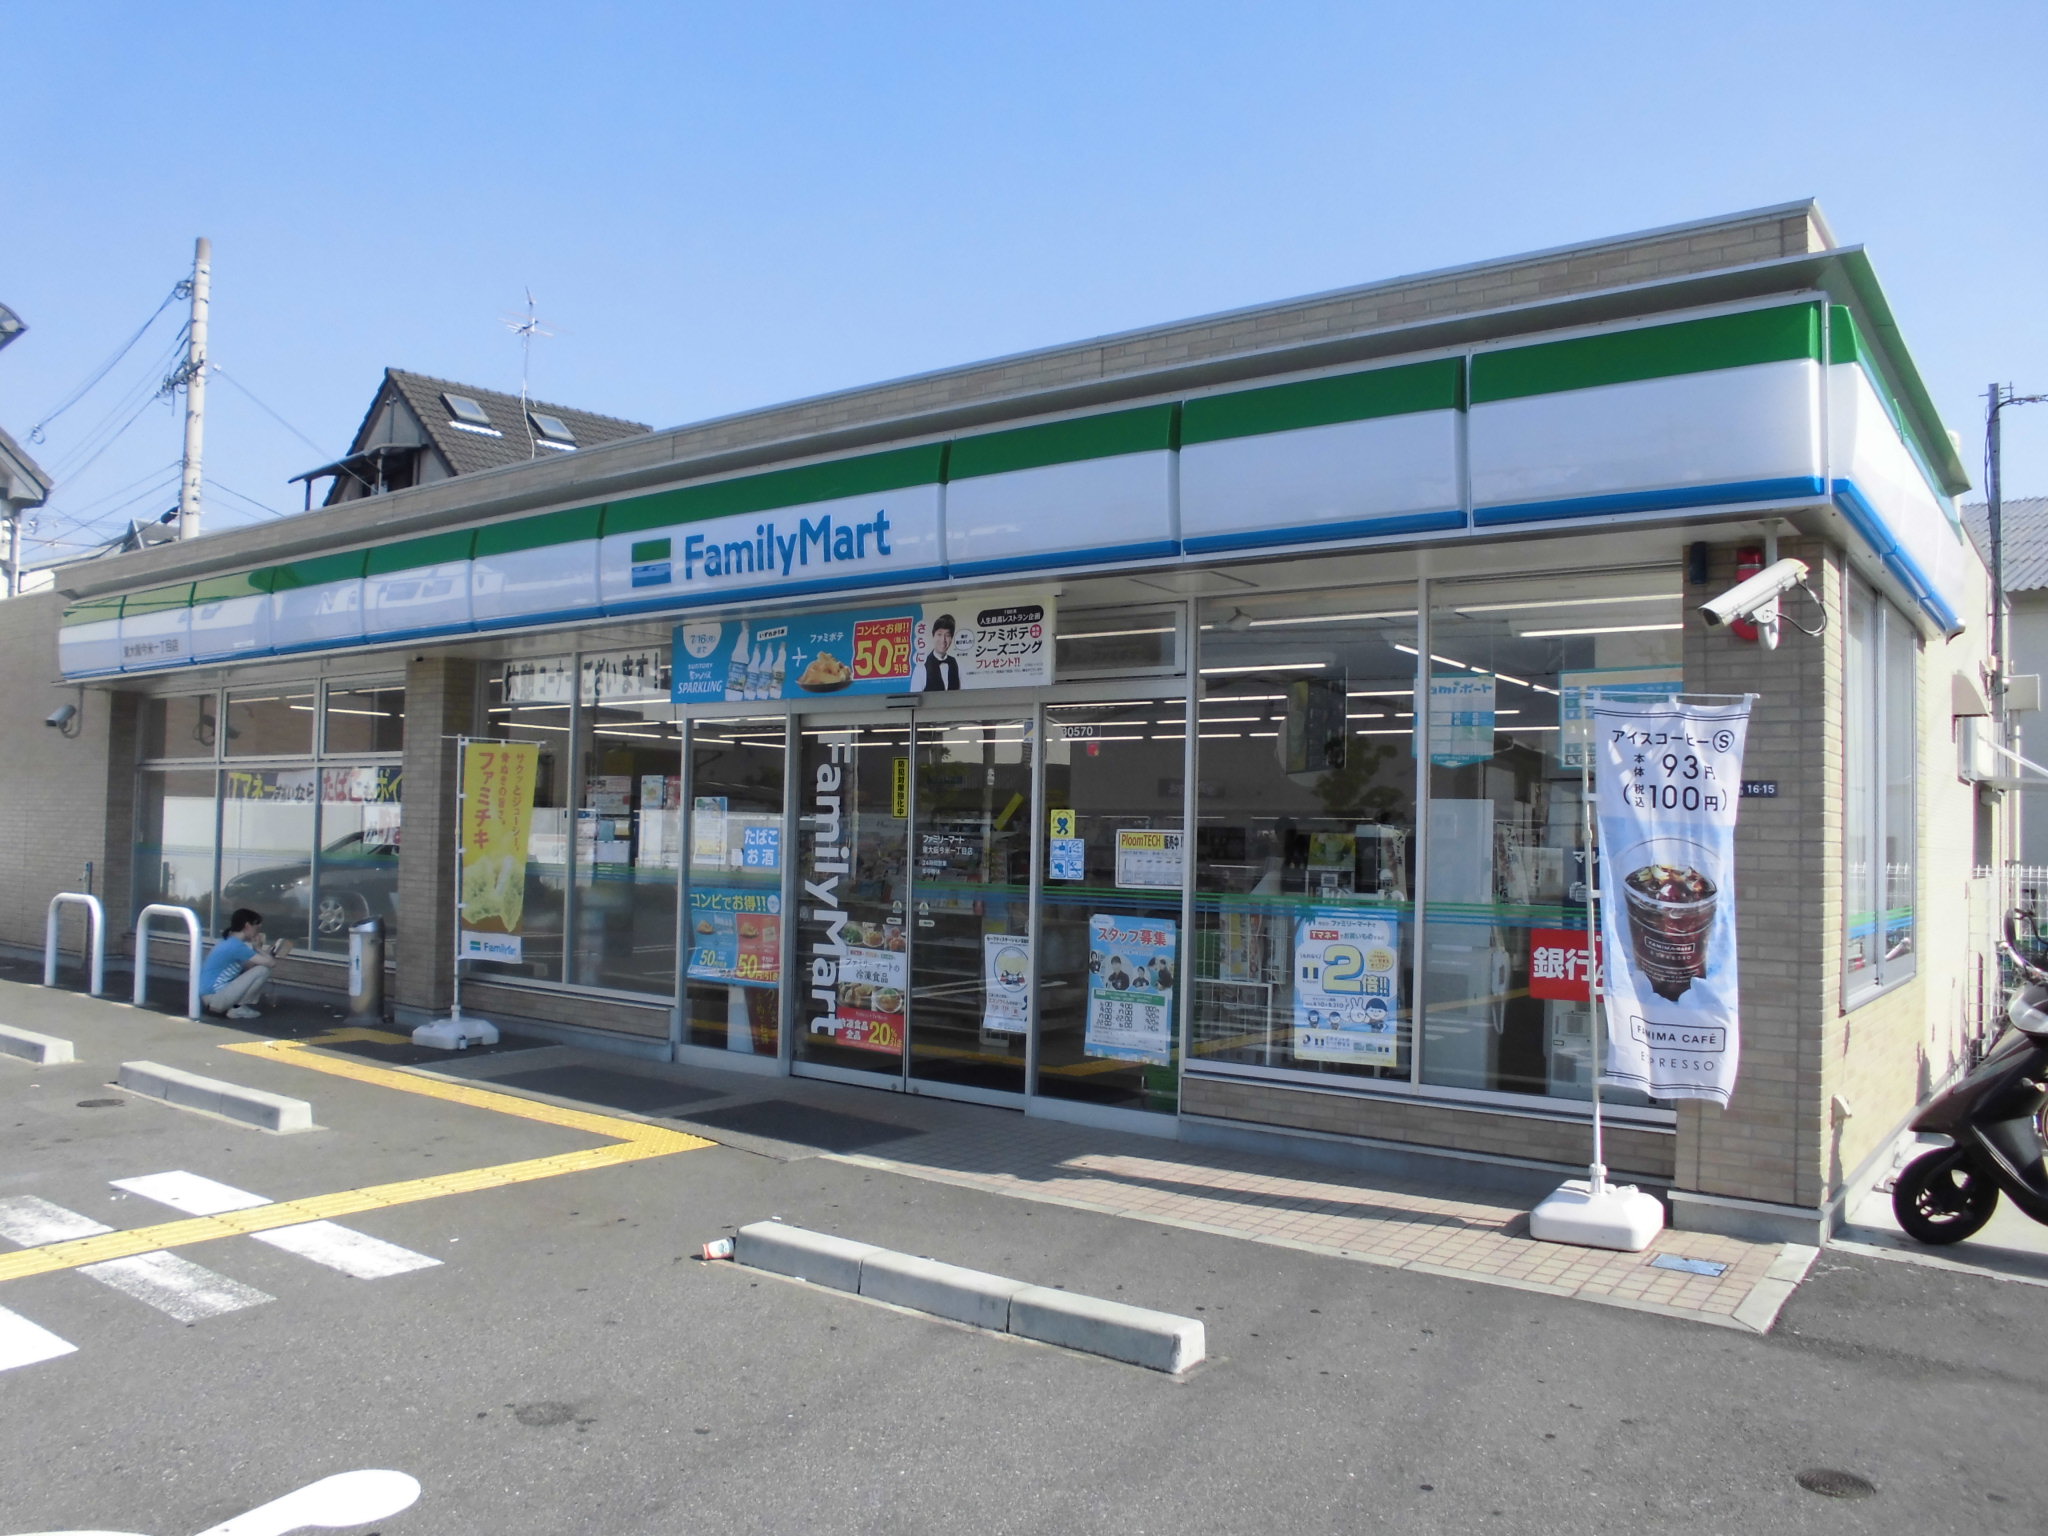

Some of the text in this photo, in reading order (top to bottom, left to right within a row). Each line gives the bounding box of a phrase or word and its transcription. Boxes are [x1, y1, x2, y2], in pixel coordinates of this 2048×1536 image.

[685, 509, 891, 580] FamilyMart
[810, 631, 845, 644] ファミポテ
[916, 623, 926, 663] さらに
[976, 626, 1029, 643] ファミポテ
[975, 640, 1043, 658] シーズニング
[976, 657, 1021, 669] プレゼント!!
[678, 680, 723, 695] SPARKLING
[1612, 729, 1710, 747] アイスコーヒー
[1633, 753, 1646, 777] 本体
[1747, 784, 1776, 794] 16-15
[473, 752, 495, 850] ファミチキ
[744, 828, 778, 846] たばこ
[922, 834, 966, 844] ファミリーマート
[747, 848, 775, 866] お酒
[804, 733, 850, 1037] FamilyMart
[690, 892, 766, 912] コンビでお得!!
[1097, 926, 1168, 946] スタッフ募集
[856, 969, 889, 984] 冷凍食品
[1682, 1032, 1717, 1045] CAFÉ
